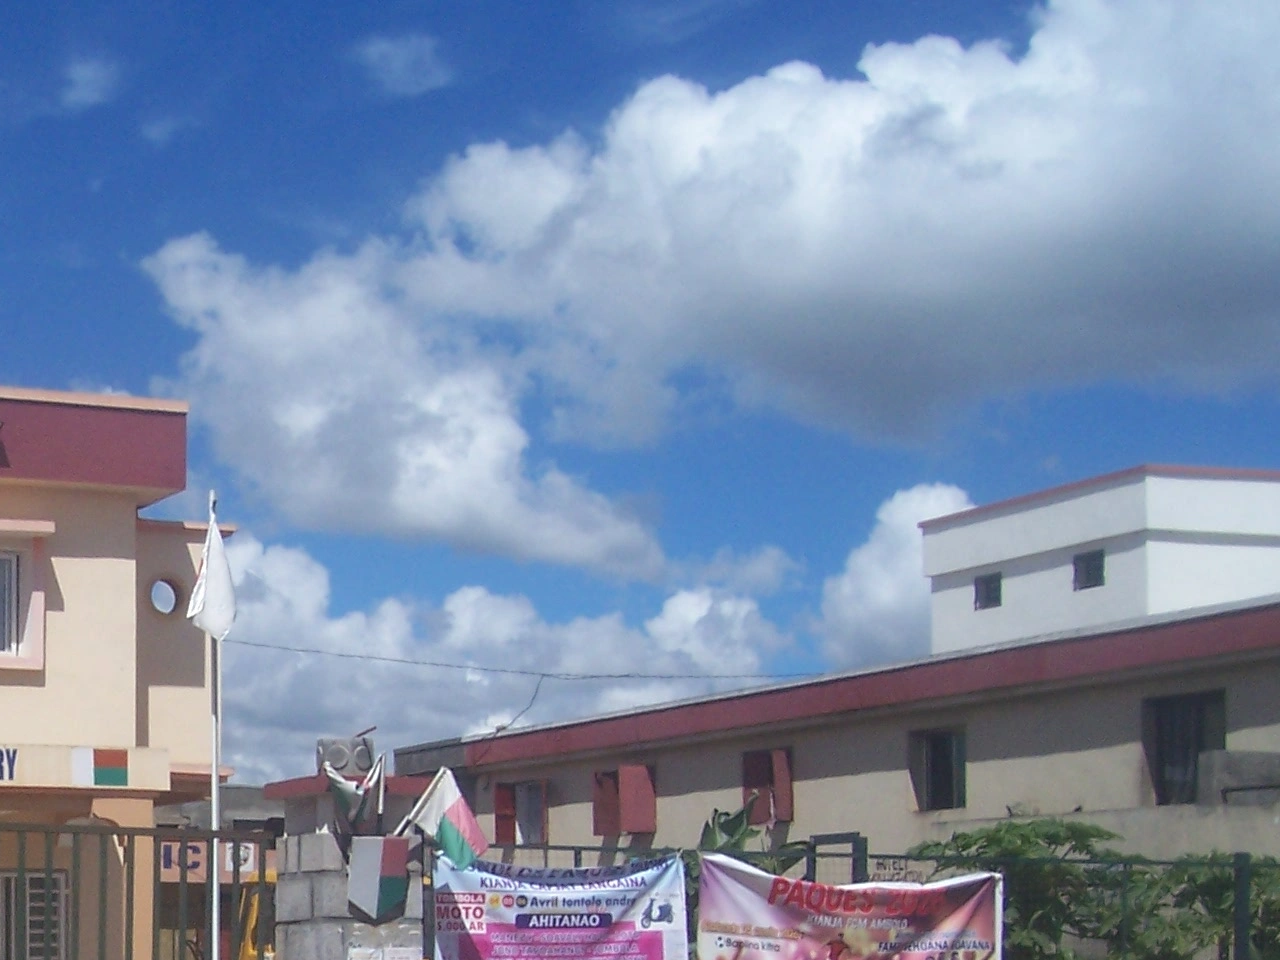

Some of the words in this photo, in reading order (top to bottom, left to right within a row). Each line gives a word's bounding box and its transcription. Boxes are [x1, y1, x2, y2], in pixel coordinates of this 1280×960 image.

[436, 895, 484, 904] TOMBOLA
[768, 877, 874, 913] PAQUES
[530, 896, 558, 907] Avril
[436, 907, 484, 920] MOTO
[469, 921, 484, 931] AR
[529, 914, 600, 927] AHITANAO
